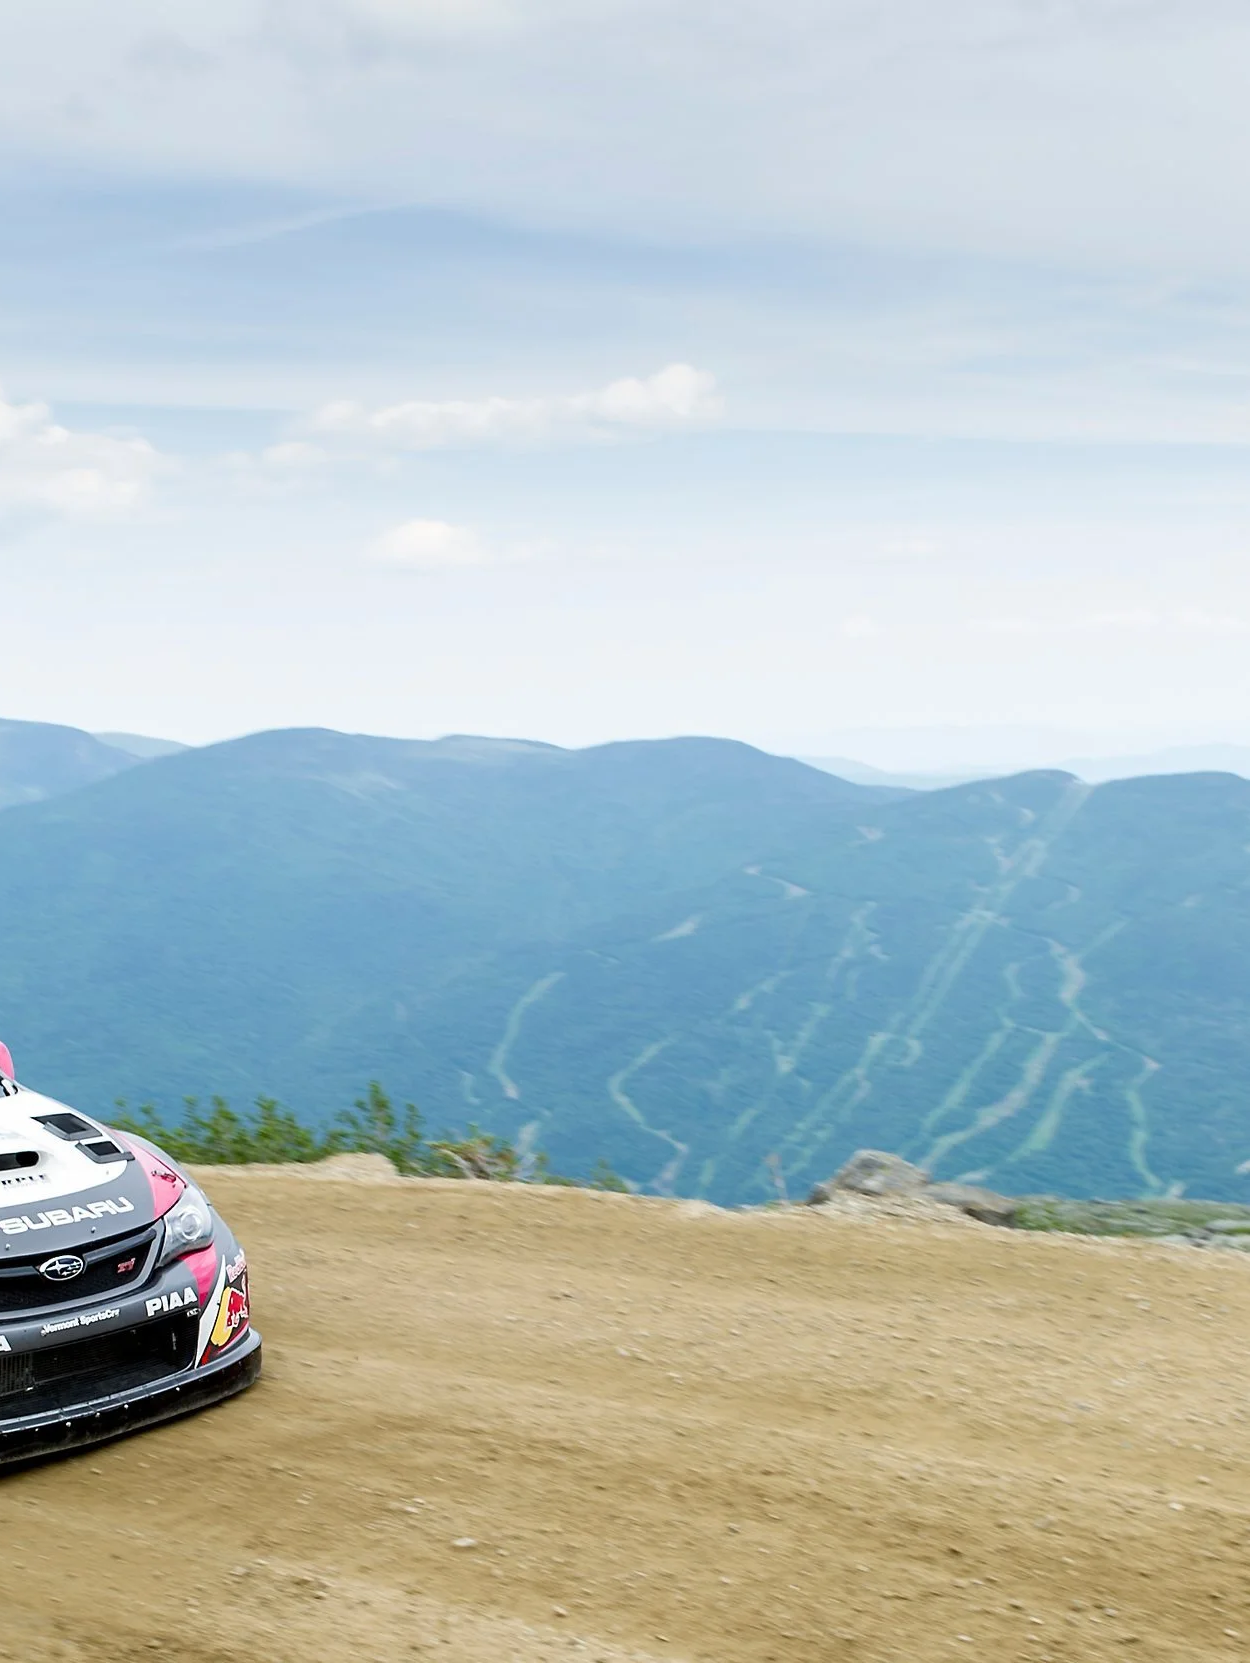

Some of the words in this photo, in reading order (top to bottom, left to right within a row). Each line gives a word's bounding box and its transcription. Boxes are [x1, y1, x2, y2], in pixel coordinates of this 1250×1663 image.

[0, 1197, 135, 1235] SUBARU
[145, 1287, 198, 1317] PIAA
[42, 1318, 80, 1334] Vermont
